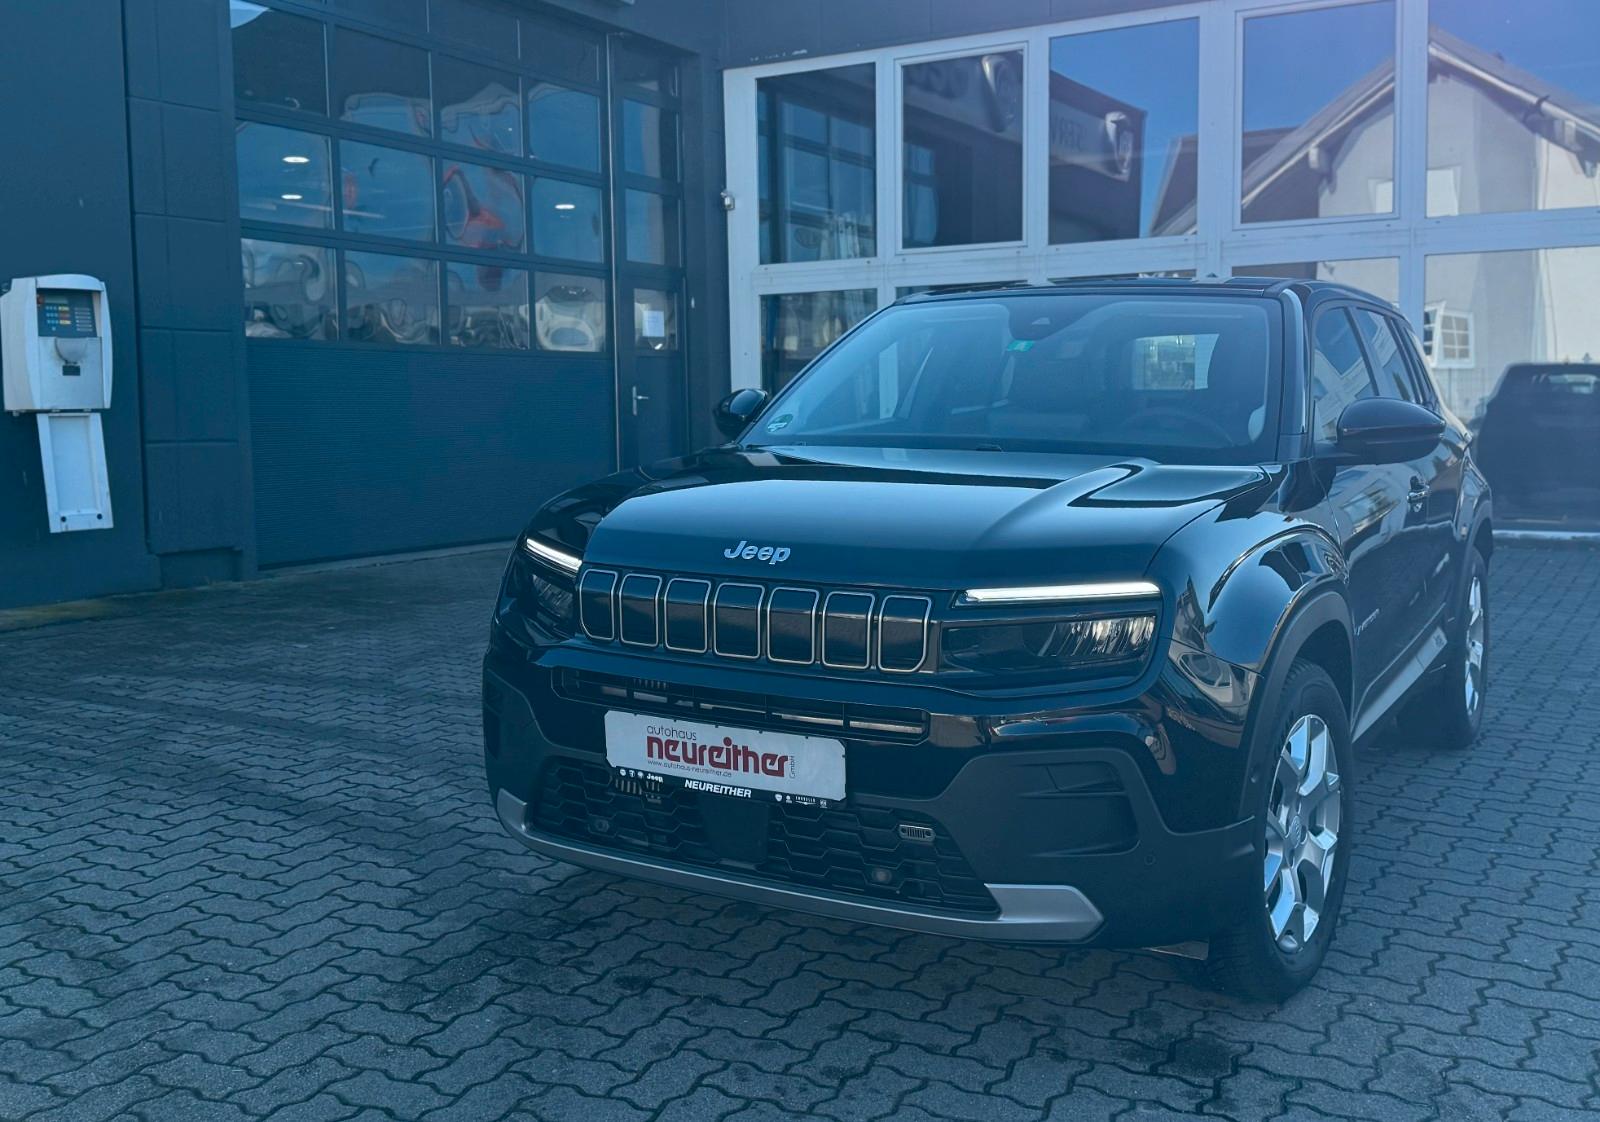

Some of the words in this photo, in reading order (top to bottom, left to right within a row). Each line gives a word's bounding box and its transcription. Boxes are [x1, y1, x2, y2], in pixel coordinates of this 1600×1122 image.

[724, 540, 791, 565] Jeep
[647, 725, 697, 741] autohaus
[646, 736, 789, 778] neureither
[685, 779, 752, 798] NEUREITHER
